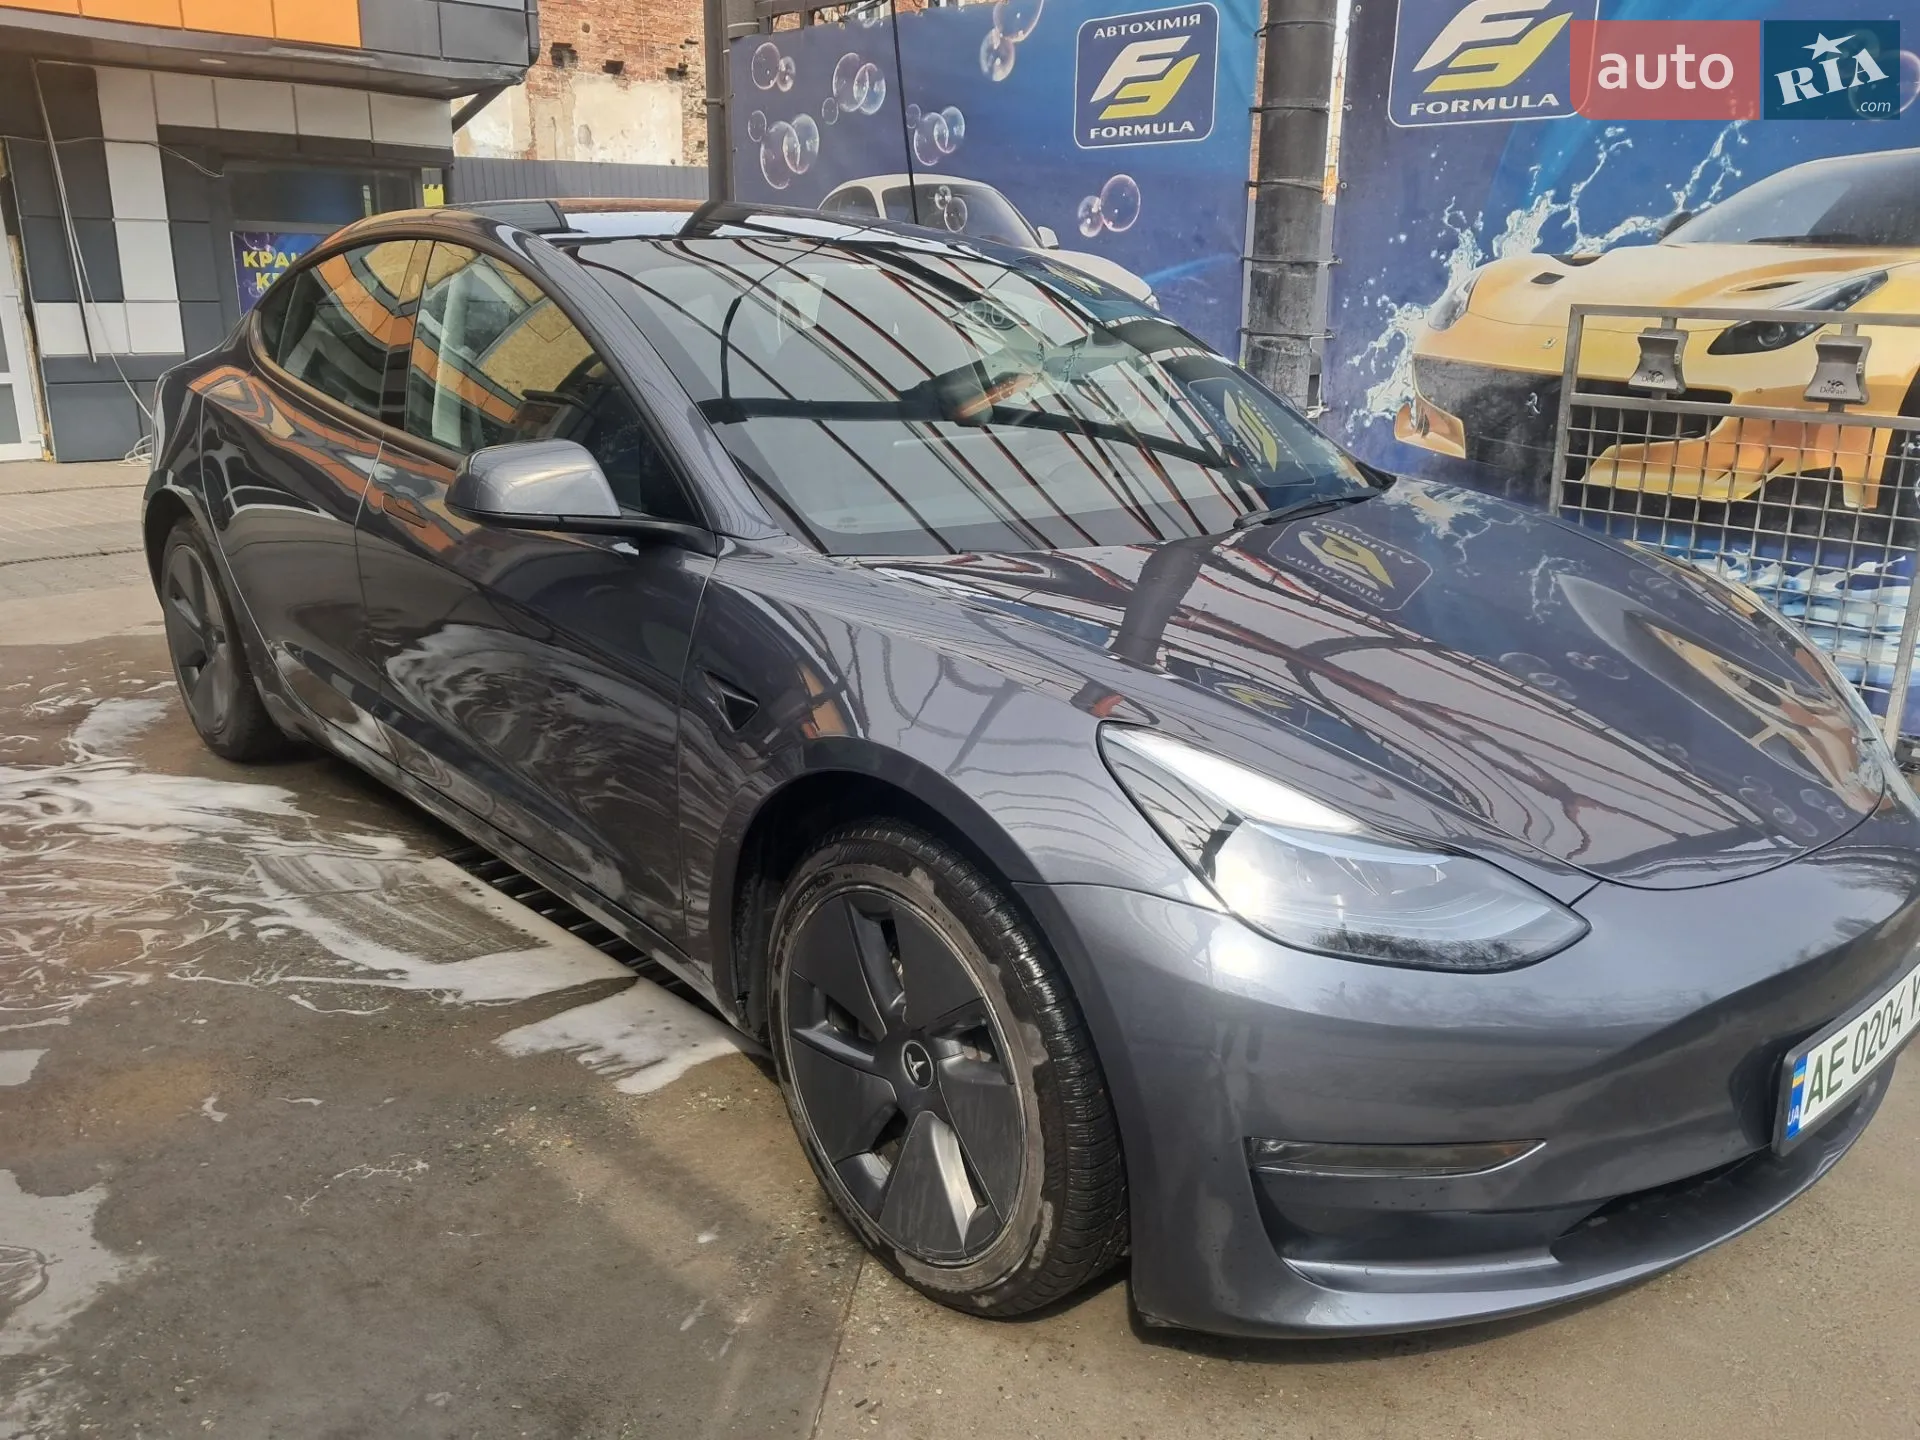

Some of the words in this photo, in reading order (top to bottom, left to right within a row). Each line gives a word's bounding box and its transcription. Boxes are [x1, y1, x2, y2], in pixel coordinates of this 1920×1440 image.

[1094, 13, 1201, 39] АВТОХІМІЯ
[1410, 93, 1559, 116] FORMULA
[1090, 120, 1195, 139] FORMULA
[1804, 1035, 1848, 1115] AE
[1852, 985, 1906, 1075] 0204
[1910, 975, 1920, 1020] Y
[1787, 1104, 1800, 1126] UA
